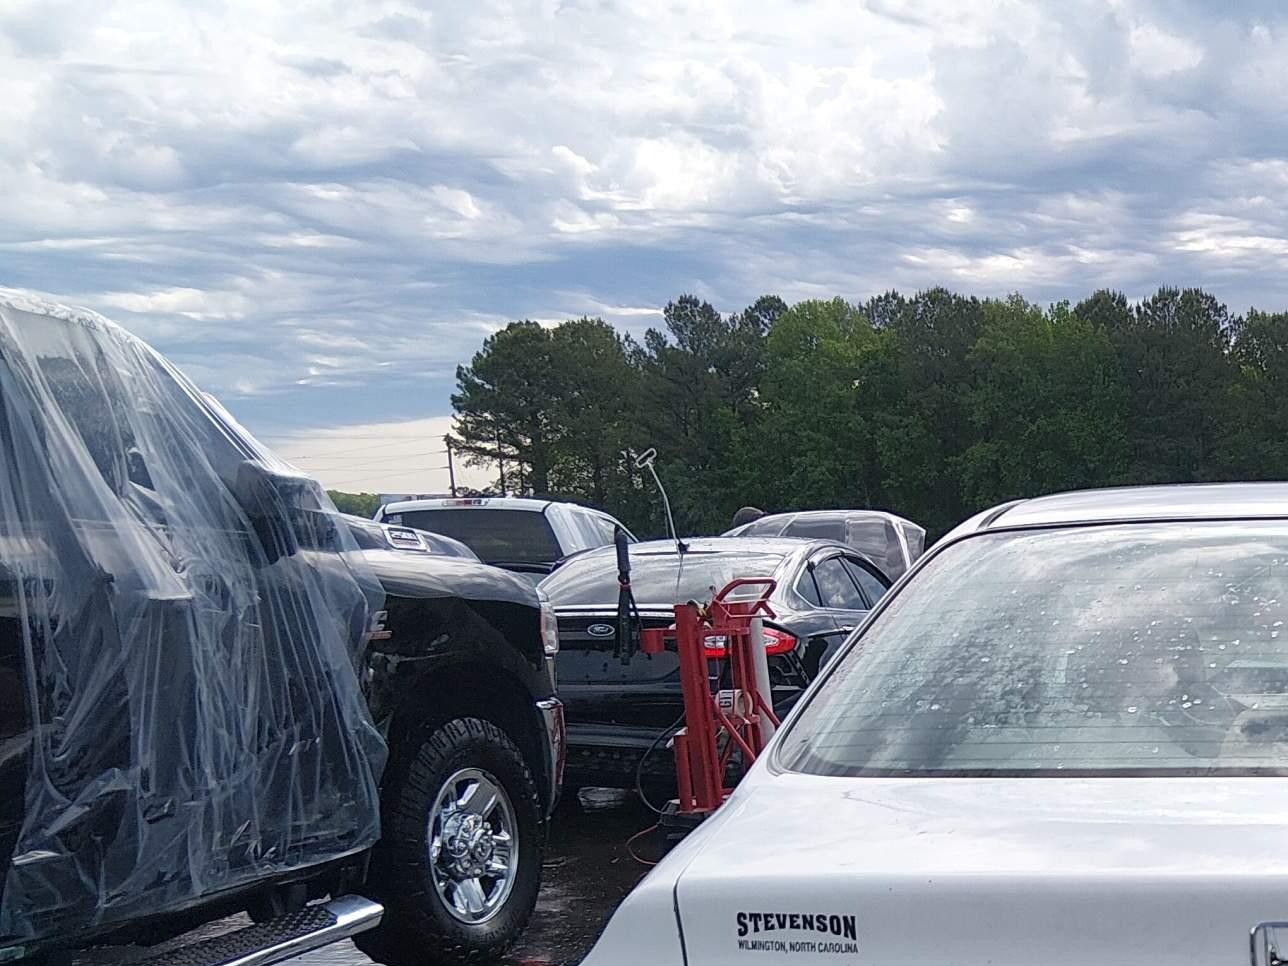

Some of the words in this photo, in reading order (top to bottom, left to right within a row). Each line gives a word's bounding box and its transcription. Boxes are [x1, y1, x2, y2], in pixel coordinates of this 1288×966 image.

[737, 912, 857, 941] STEVENSON
[738, 940, 788, 954] WILMINGTON,
[789, 942, 816, 953] NORTH
[818, 942, 858, 954] CAROLINA
